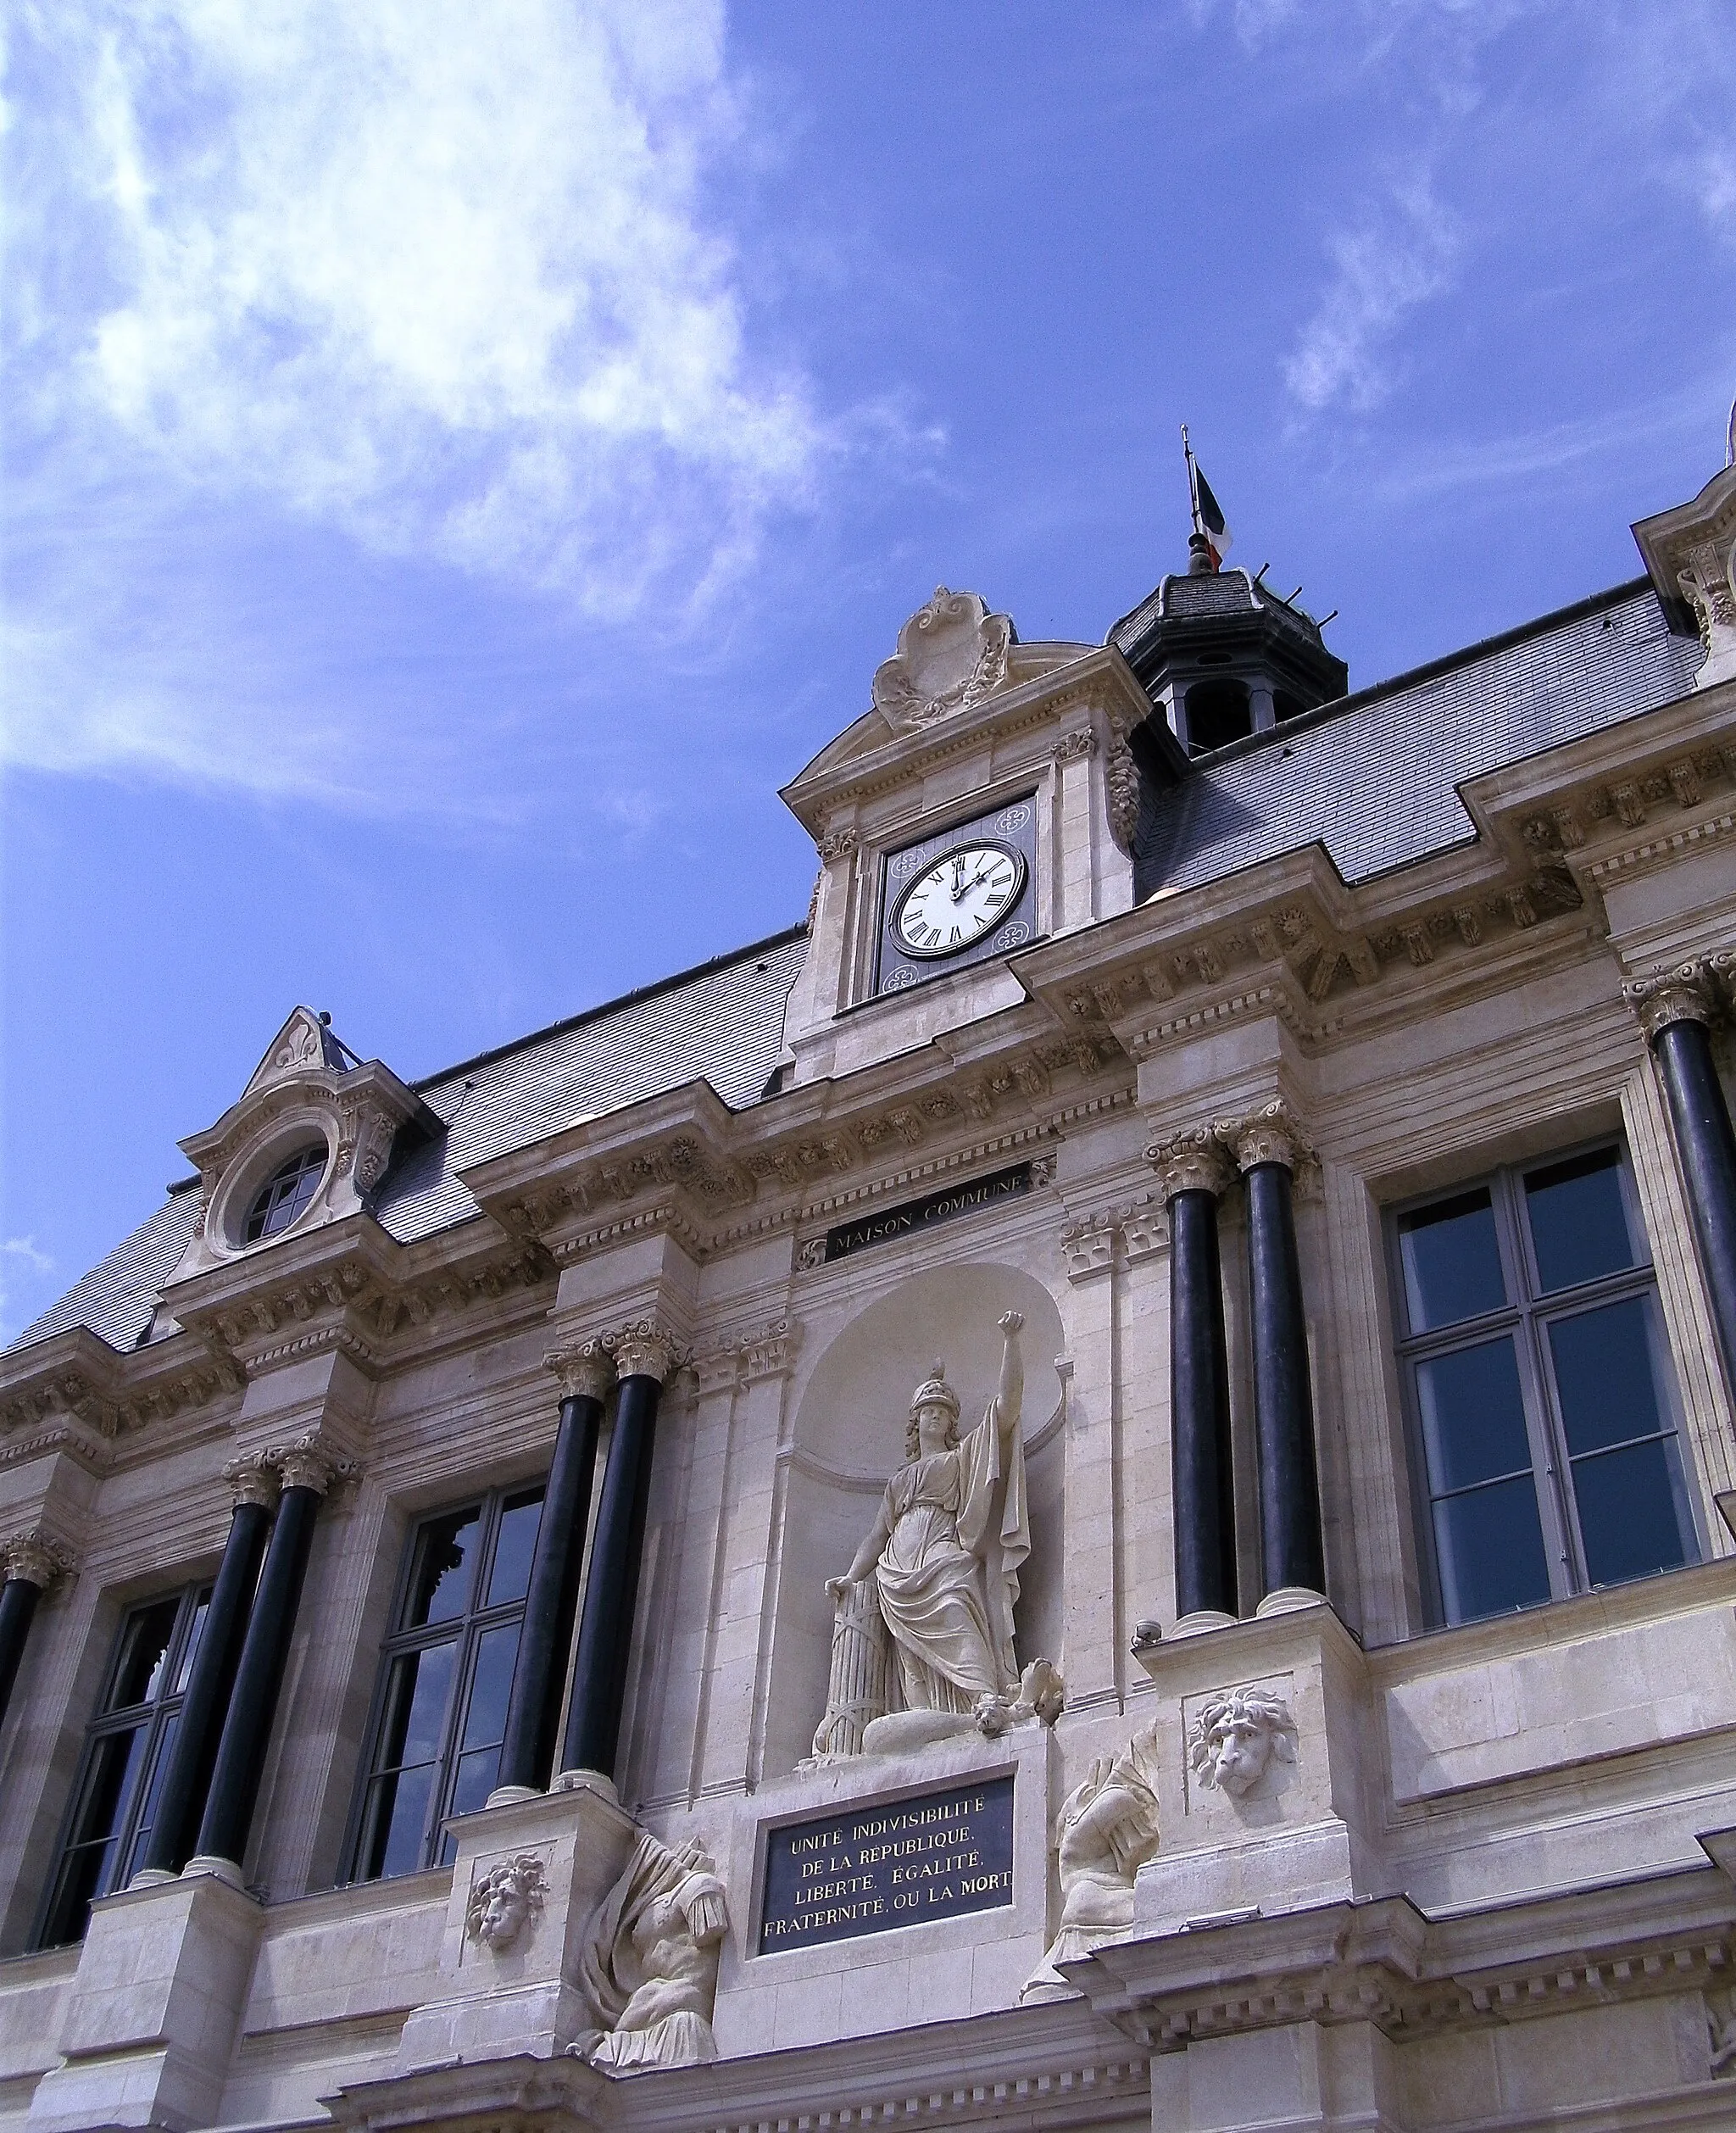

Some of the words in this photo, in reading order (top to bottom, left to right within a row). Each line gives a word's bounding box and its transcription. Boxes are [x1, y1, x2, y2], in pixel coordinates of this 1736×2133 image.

[927, 870, 945, 886] XI
[992, 872, 1012, 888] III
[983, 894, 1007, 907] IIII
[973, 914, 988, 927] V
[949, 925, 962, 944] VI
[836, 1212, 913, 1252] MAISON
[924, 1175, 1022, 1220] COMMUNE
[790, 1827, 843, 1855] UNITÉ
[852, 1794, 986, 1841] INDIVISIBILITÉ
[801, 1859, 824, 1878] DE
[829, 1855, 852, 1872] LA
[893, 1890, 920, 1909] OU
[928, 1885, 954, 1902] LA
